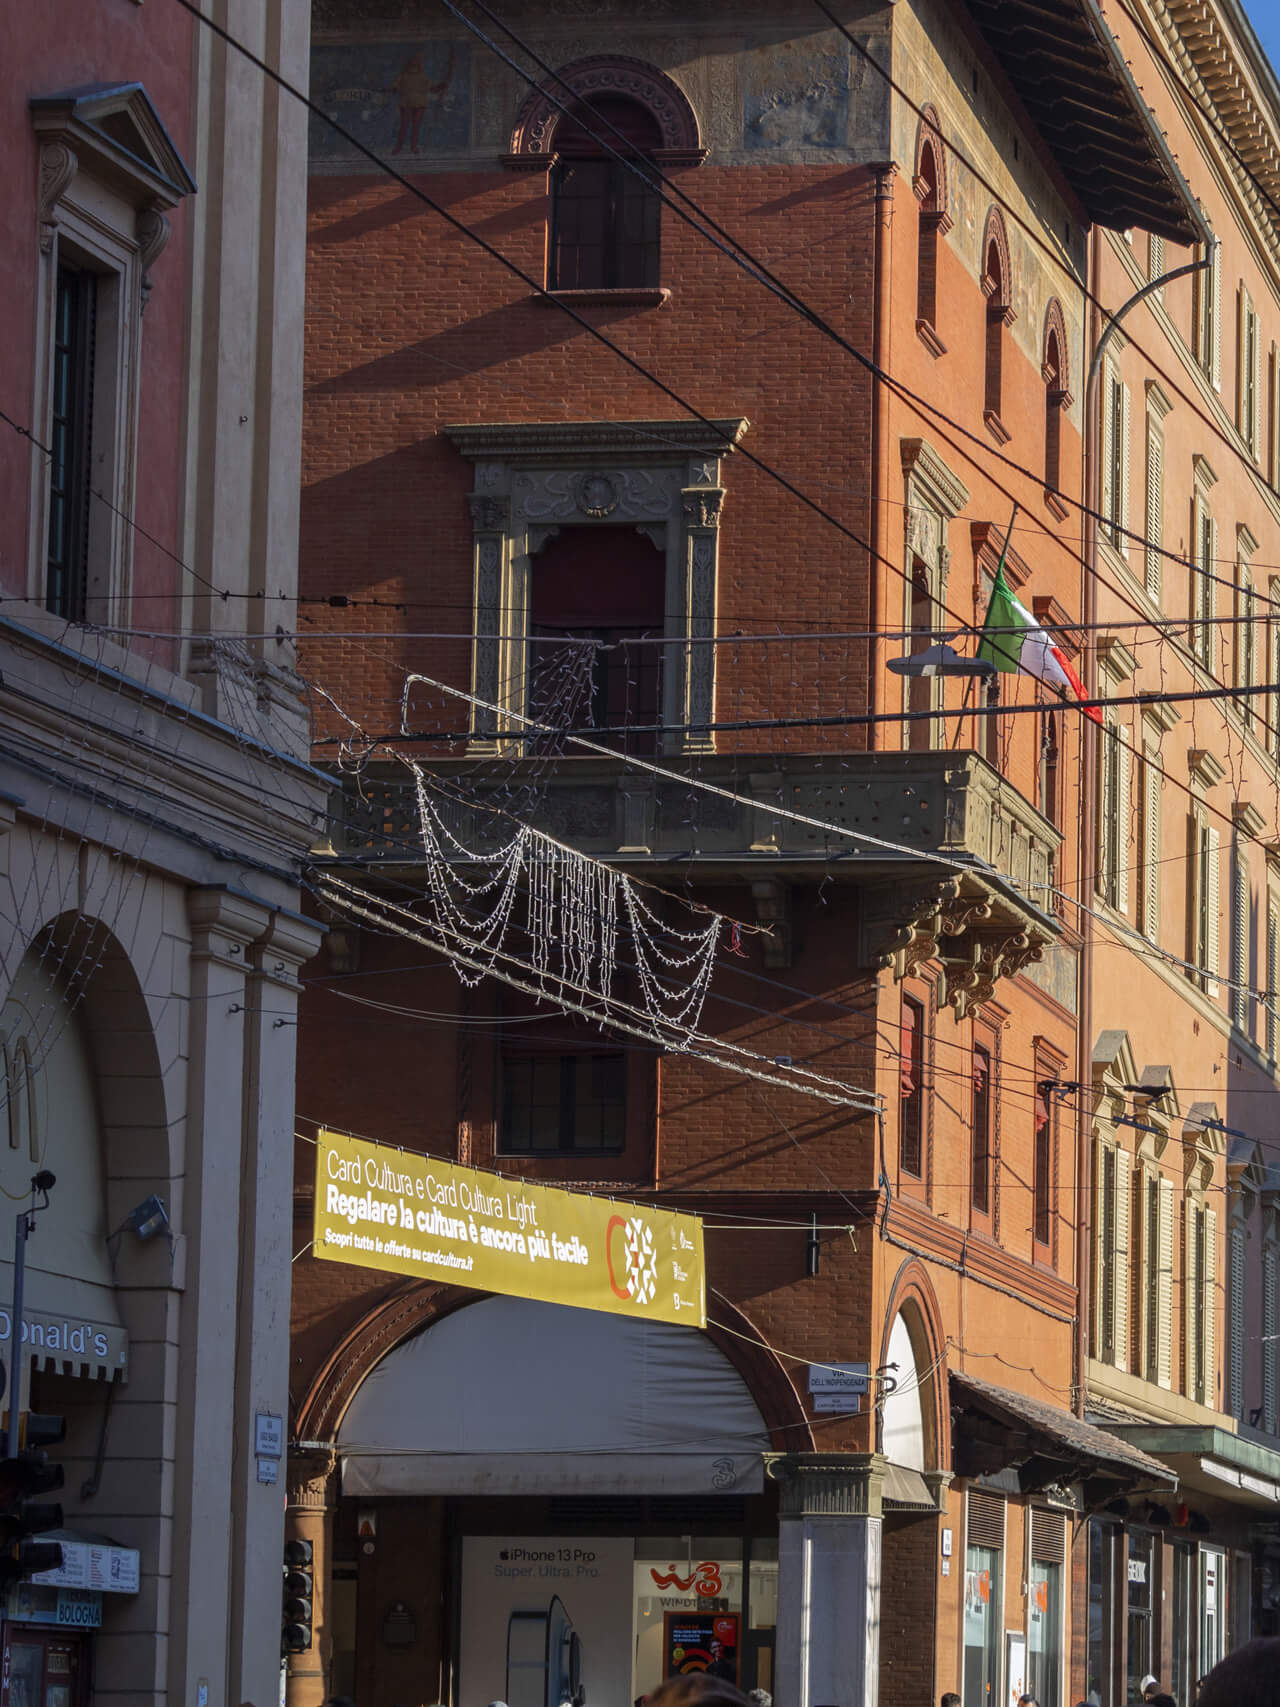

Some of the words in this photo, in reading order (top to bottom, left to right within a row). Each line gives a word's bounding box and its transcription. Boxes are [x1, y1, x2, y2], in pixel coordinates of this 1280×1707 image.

[327, 1150, 361, 1184] Card
[364, 1159, 414, 1197] Cultura
[415, 1178, 425, 1199] e
[425, 1175, 457, 1207] Card
[460, 1183, 503, 1218] Cultura
[506, 1193, 538, 1230] Light
[326, 1184, 397, 1226] Regalare
[399, 1198, 414, 1230] la
[416, 1206, 469, 1242] cultura
[468, 1214, 479, 1244] è
[480, 1225, 527, 1255] ancora
[527, 1229, 551, 1262] più
[551, 1232, 589, 1265] facile
[325, 1227, 353, 1249] Scopri
[353, 1234, 374, 1251] tutte
[375, 1237, 384, 1253] le
[384, 1239, 411, 1259] offerte
[412, 1247, 422, 1260] su
[422, 1249, 474, 1271] cardcultura.it
[832, 1369, 846, 1377] VIA
[510, 1548, 555, 1561] iPhone
[557, 1548, 571, 1561] 13
[573, 1548, 596, 1561] Pro
[59, 1603, 101, 1625] BOLOGNA
